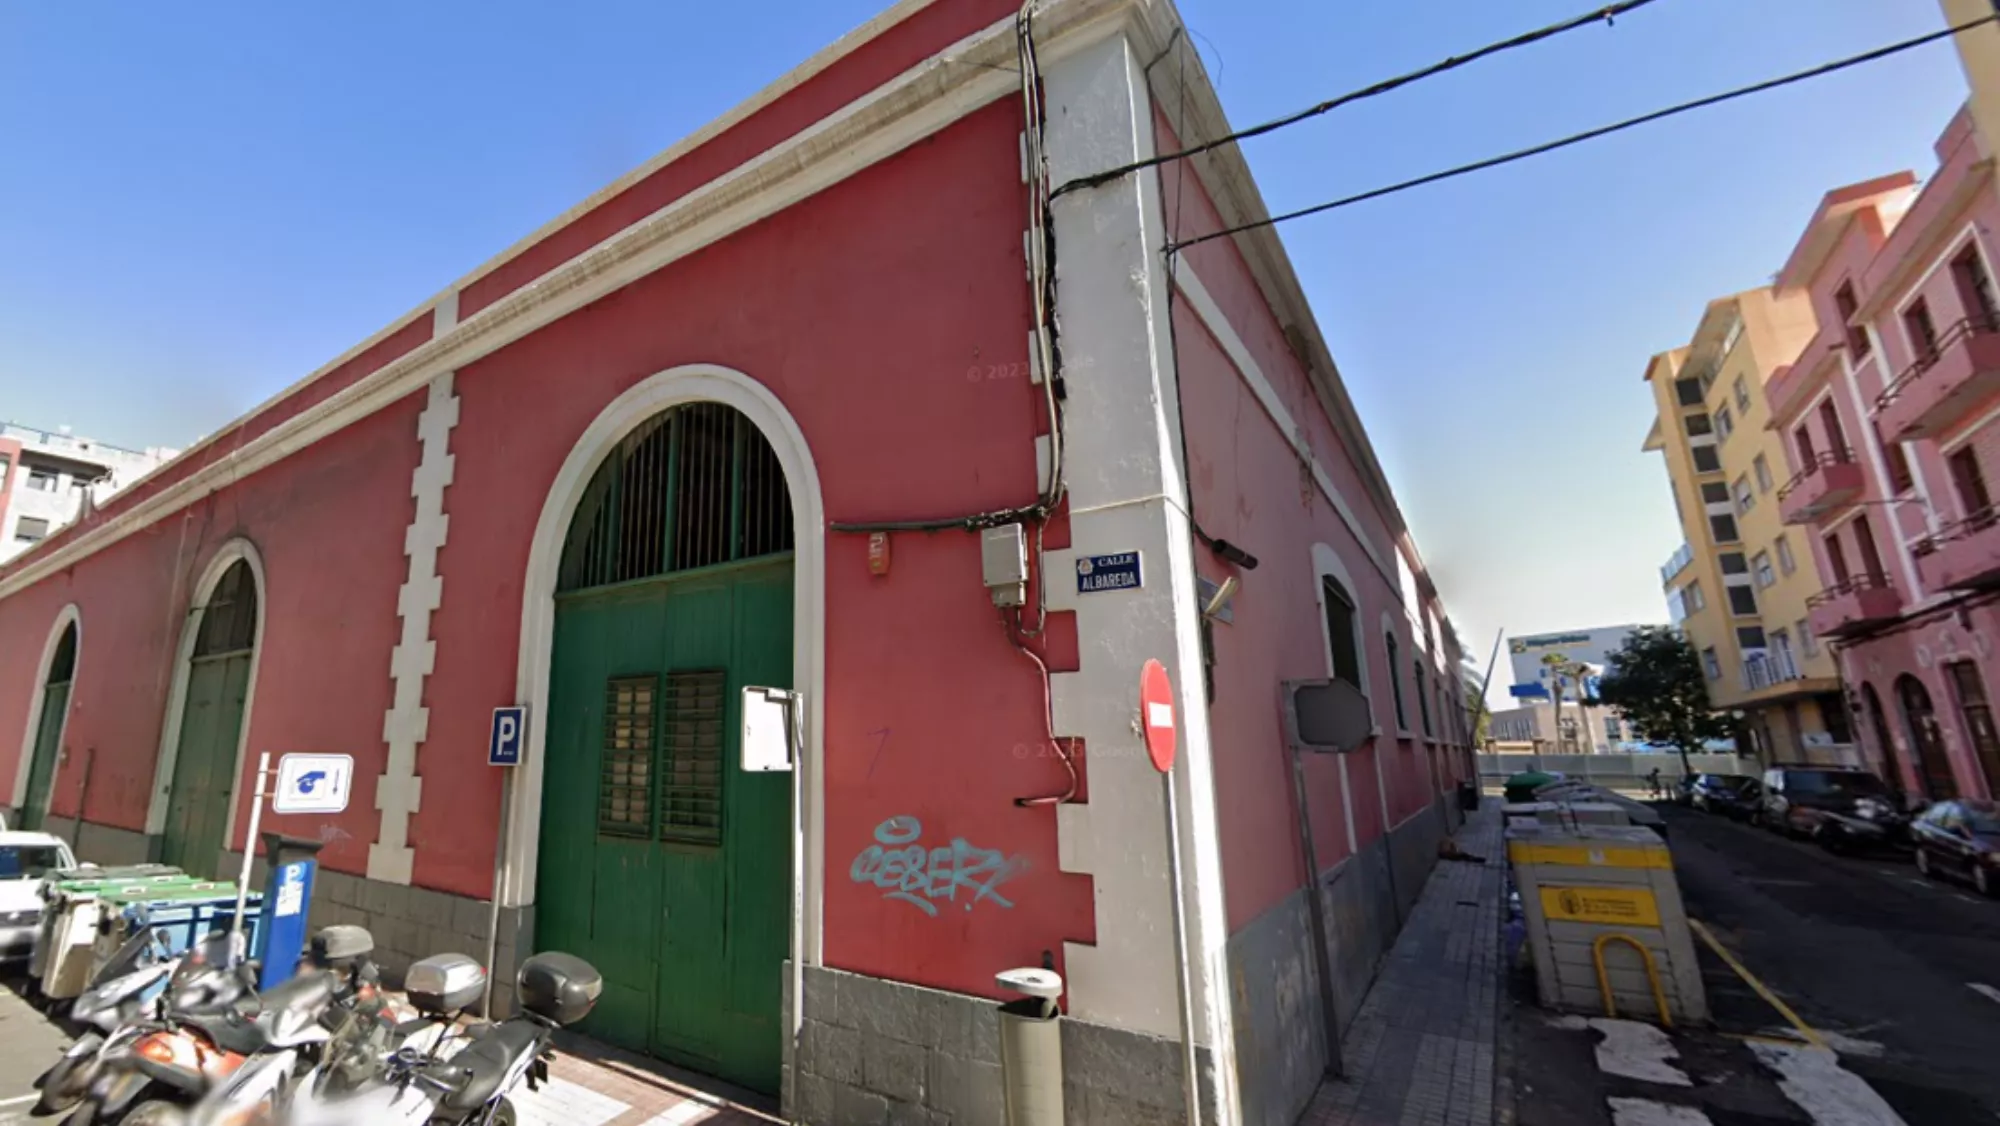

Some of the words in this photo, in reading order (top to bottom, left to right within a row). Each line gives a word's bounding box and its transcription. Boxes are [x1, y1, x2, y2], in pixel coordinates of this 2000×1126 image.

[1098, 554, 1135, 567] CALLE
[1082, 571, 1137, 591] ALBAREDA
[496, 716, 515, 756] P
